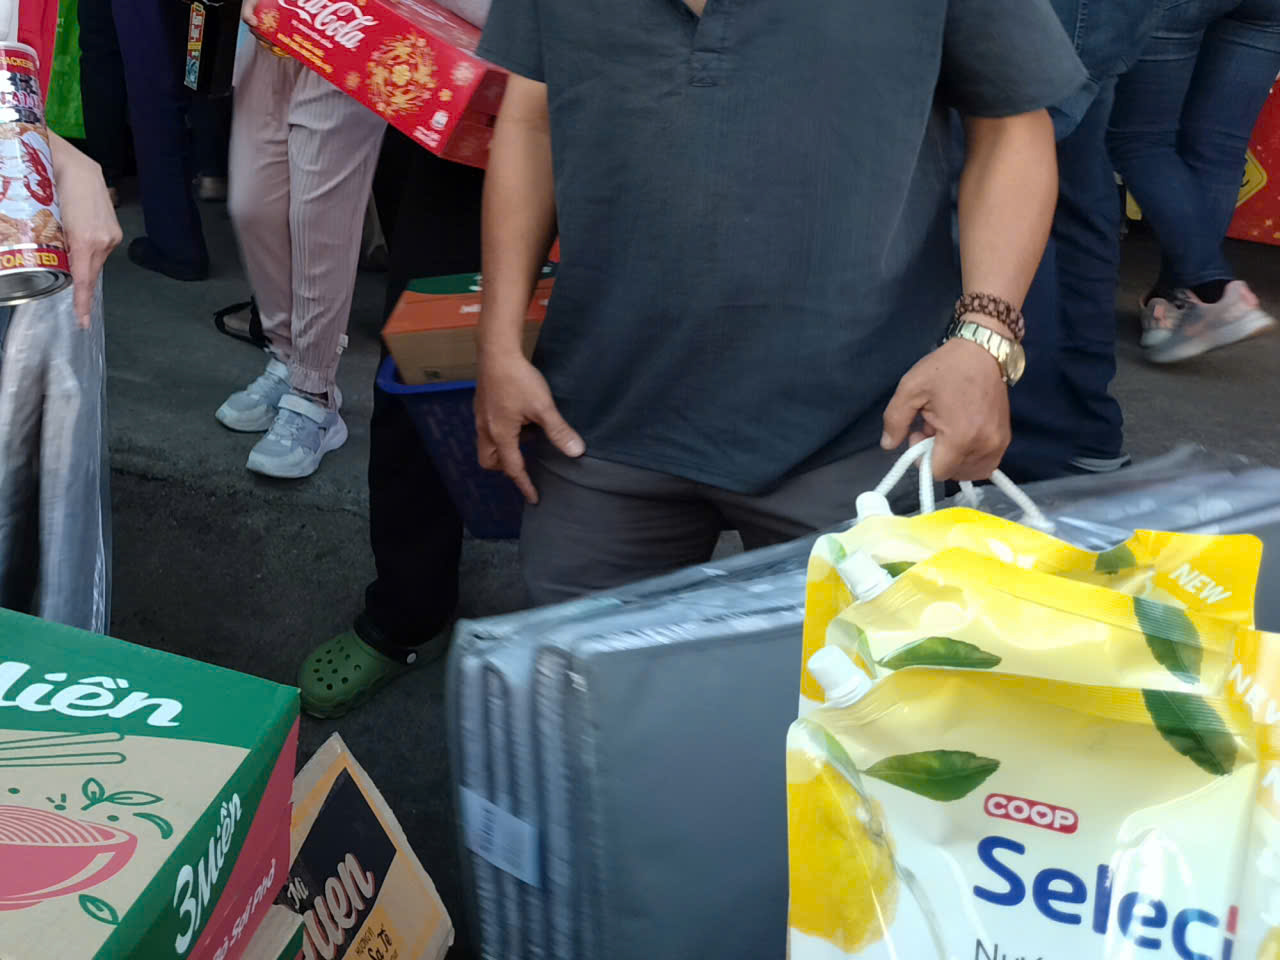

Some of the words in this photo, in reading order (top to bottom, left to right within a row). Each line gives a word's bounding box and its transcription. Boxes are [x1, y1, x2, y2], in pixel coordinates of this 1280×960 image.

[1168, 562, 1233, 607] NEW
[987, 796, 1076, 829] COOP
[303, 852, 376, 960] uen
